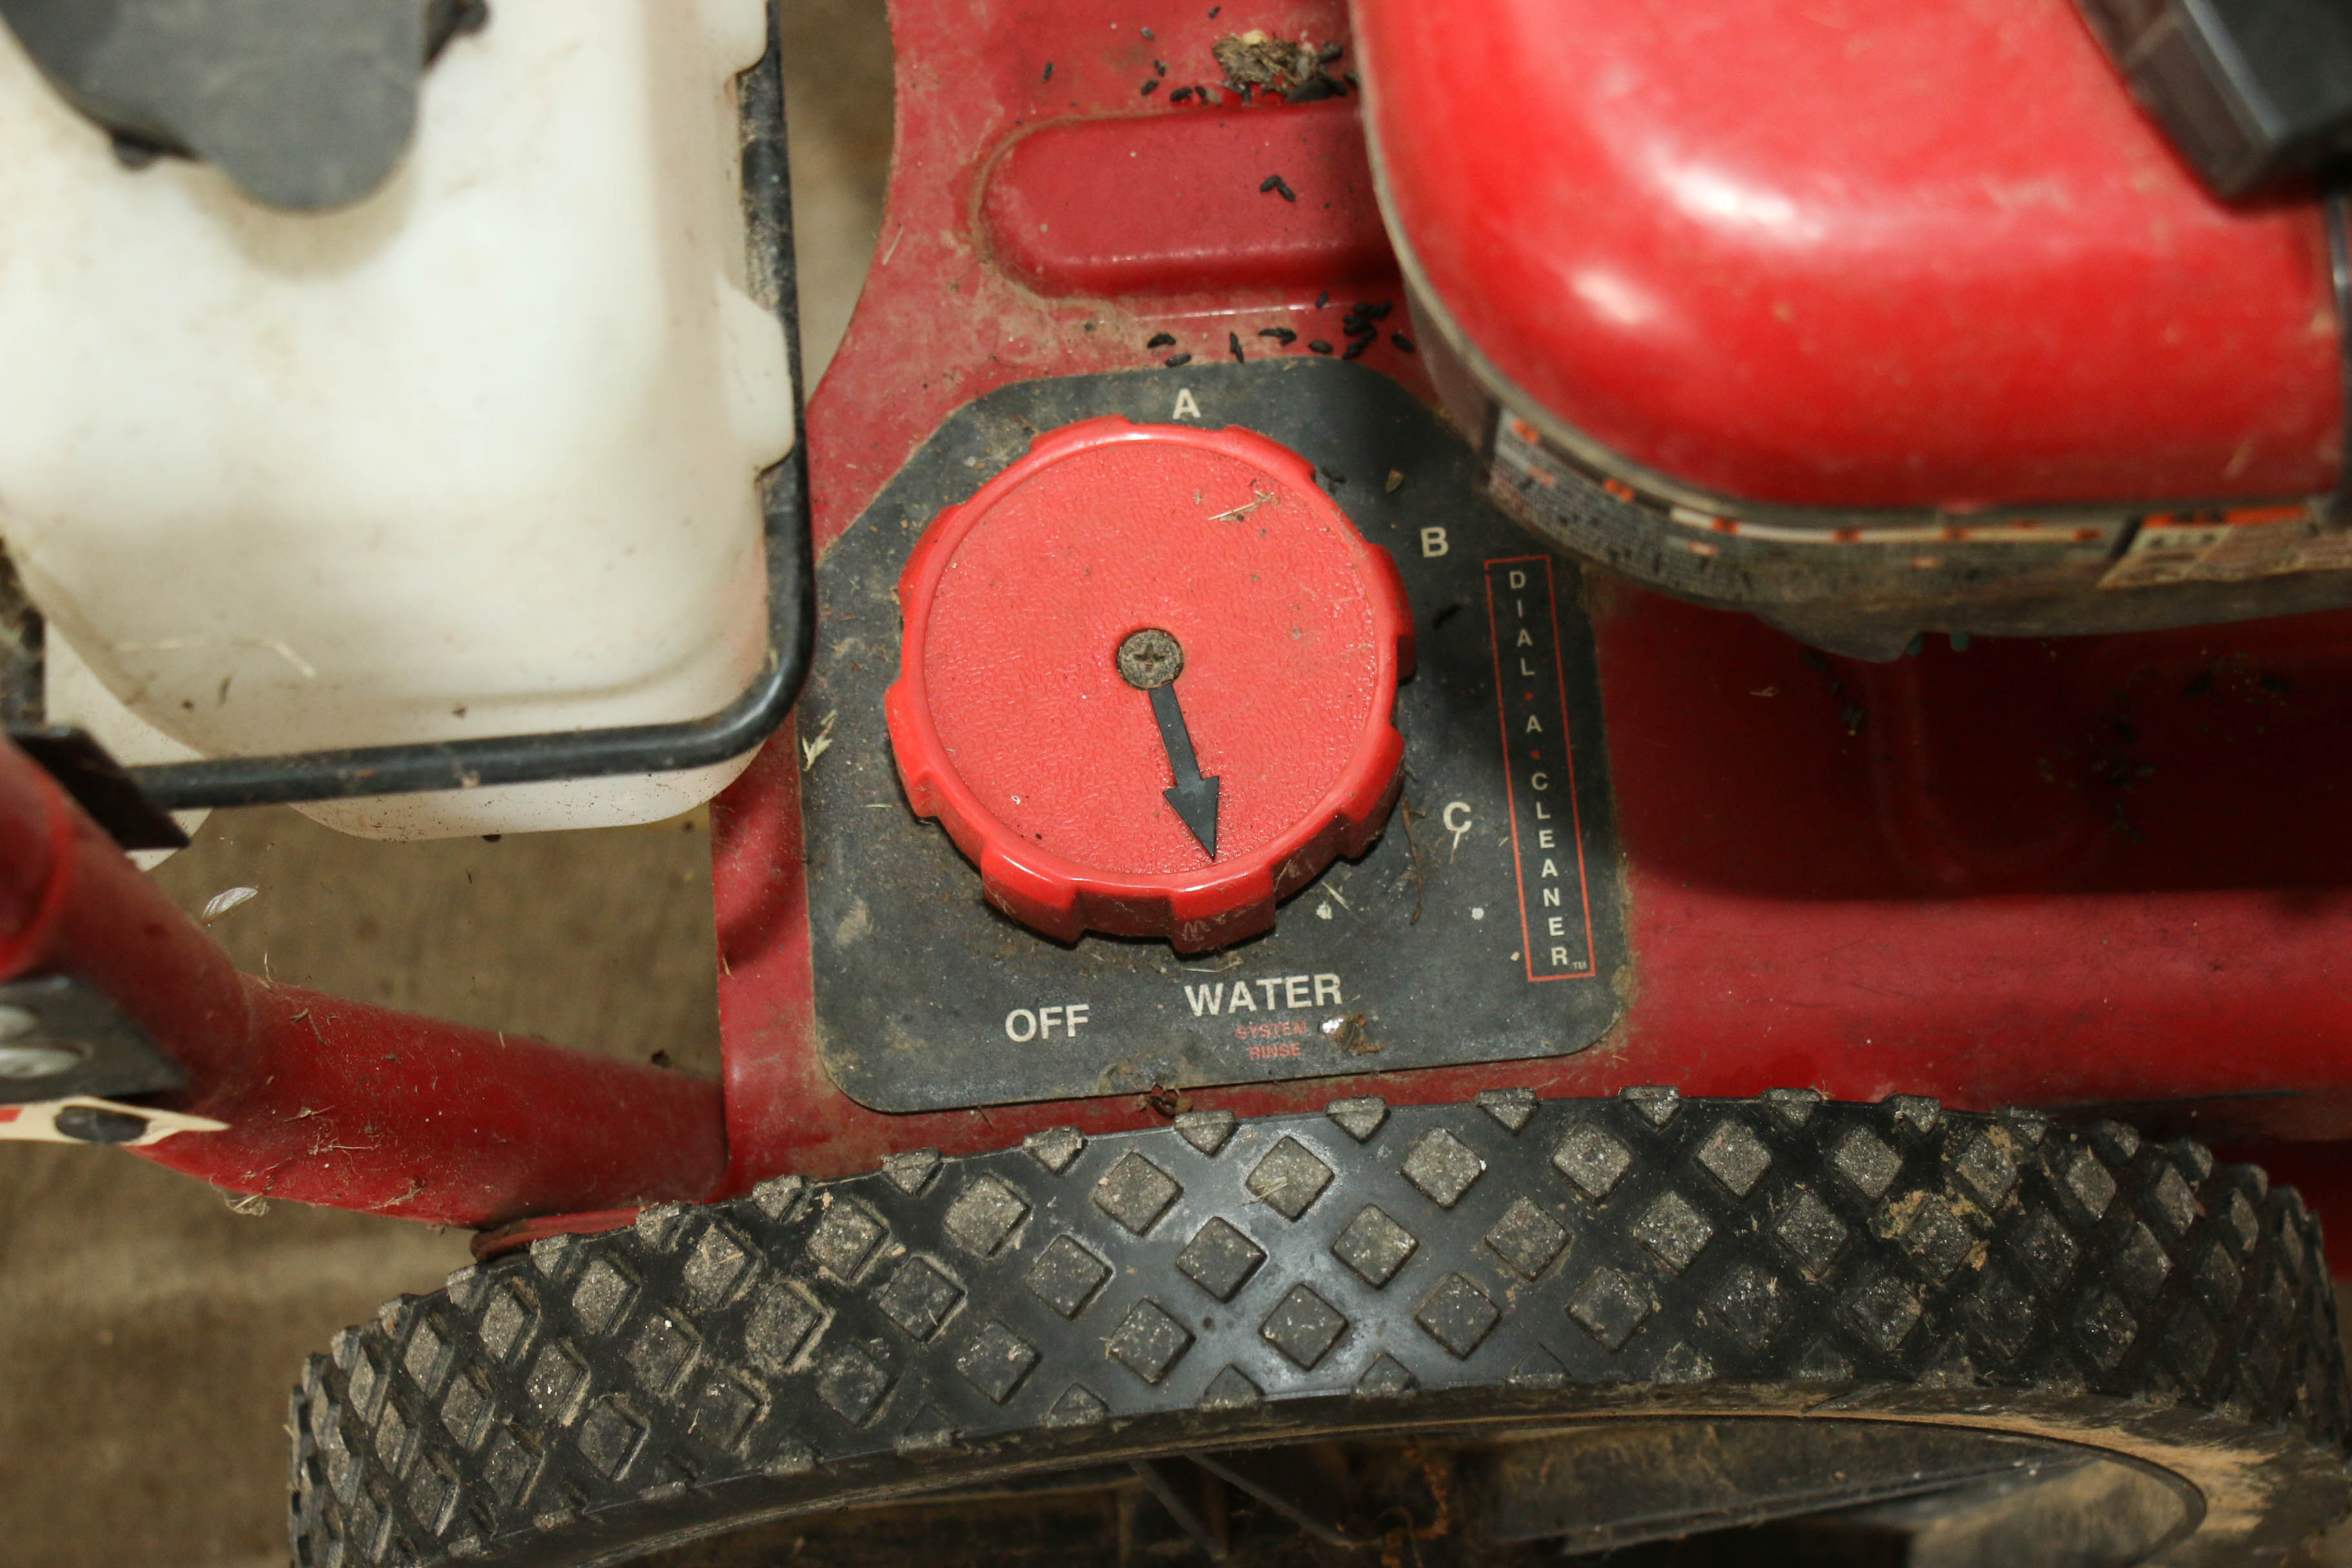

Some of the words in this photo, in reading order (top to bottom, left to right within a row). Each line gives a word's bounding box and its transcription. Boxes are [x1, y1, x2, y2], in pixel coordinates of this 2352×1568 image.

[1172, 388, 1201, 420] A
[1420, 526, 1449, 558] B
[1509, 570, 1535, 676] DIAL
[1526, 714, 1543, 733] A
[1443, 802, 1472, 833] C
[1531, 772, 1568, 966] CLEANER
[1184, 972, 1343, 1017] WATER
[1005, 1003, 1090, 1043] OFF
[1236, 1019, 1308, 1040] SYSTEM
[1249, 1042, 1301, 1060] RINSE
